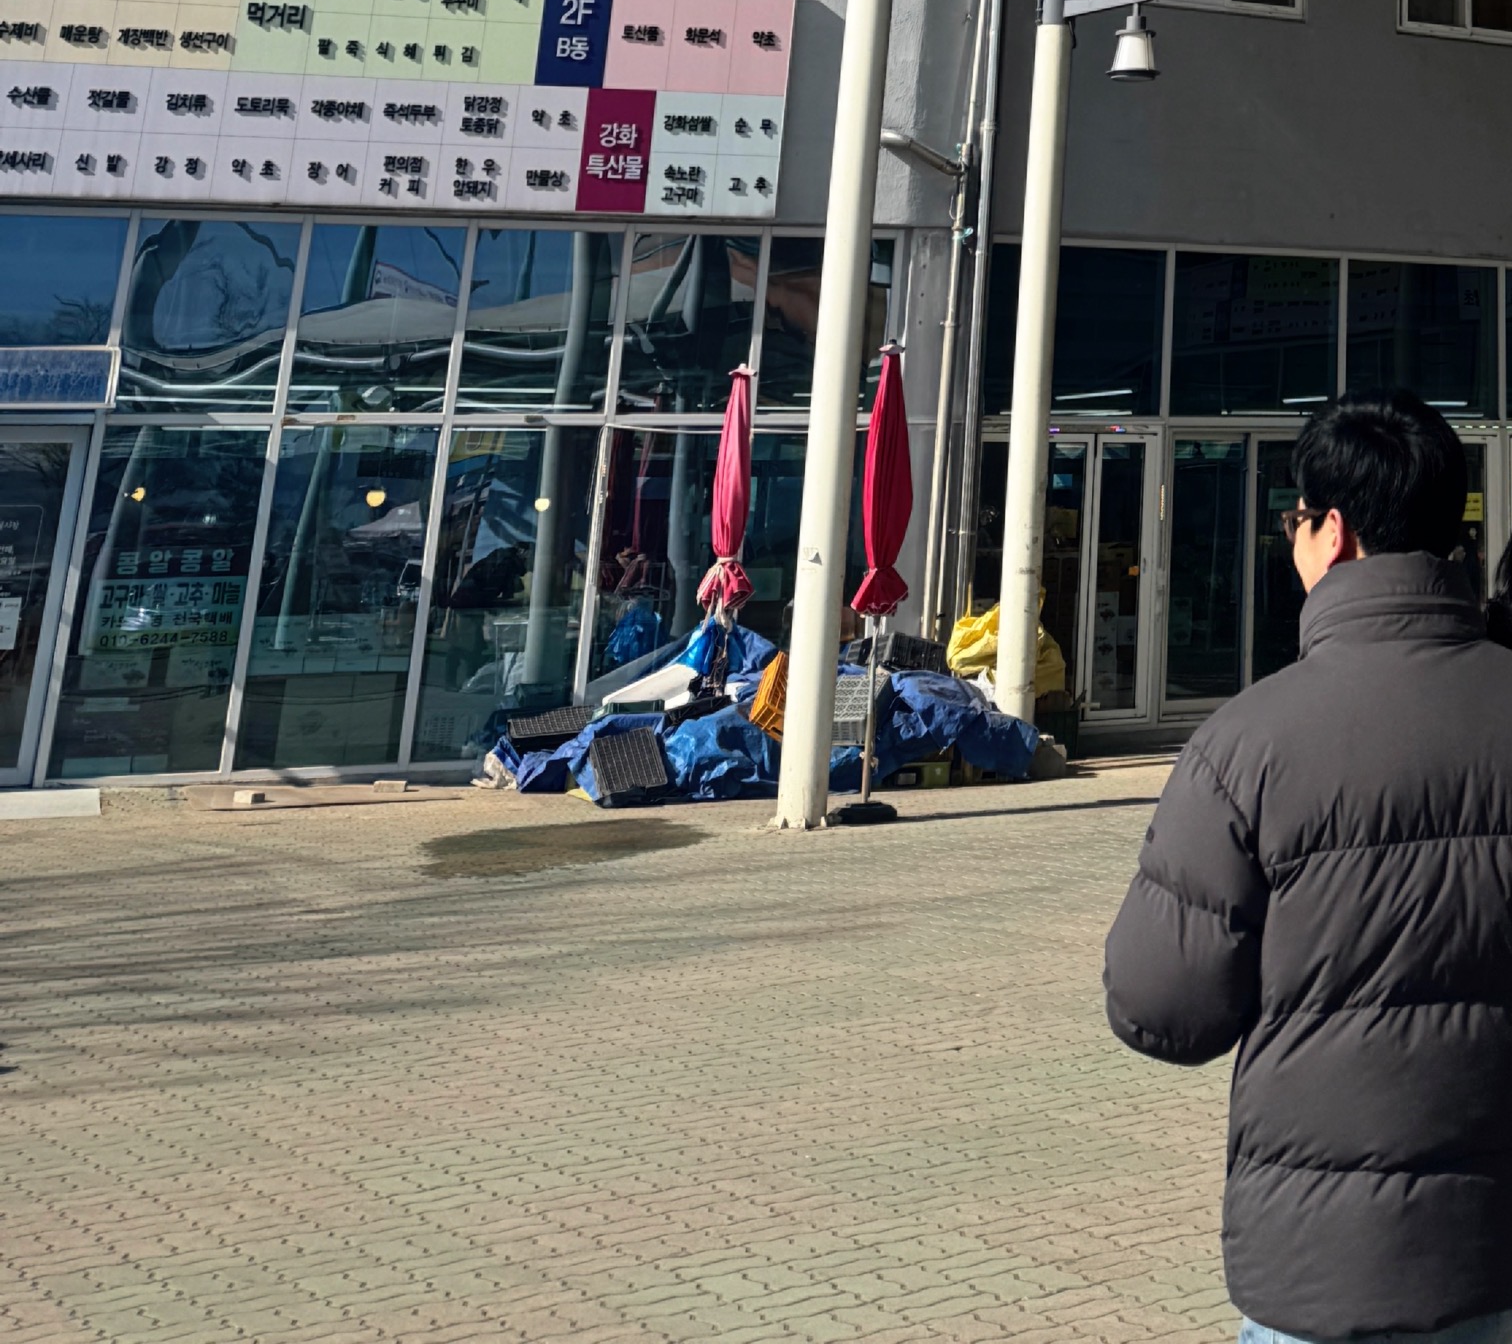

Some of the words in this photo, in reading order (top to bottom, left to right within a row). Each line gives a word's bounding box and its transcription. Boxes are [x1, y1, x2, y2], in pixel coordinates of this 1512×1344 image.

[248, 3, 306, 29] 먹거리
[60, 25, 103, 43] 매운탕
[118, 29, 168, 46] 게장백반
[180, 32, 229, 49] 생선구이
[623, 26, 659, 41] 토산품
[685, 28, 721, 44] 화문석
[753, 32, 775, 46] 약초
[556, 37, 590, 61] B동
[8, 87, 51, 105] 수산물
[167, 94, 206, 111] 김치류
[465, 96, 502, 113] 닭강정
[235, 98, 289, 115] 도토리묵
[312, 101, 364, 118] 각종야채
[384, 104, 436, 121] 즉석두부
[460, 118, 499, 134] 토종닭
[665, 116, 712, 132] 강화섬쌀
[599, 123, 638, 149] 강화
[384, 156, 422, 173] 편의점
[586, 155, 643, 181] 특산물
[527, 170, 564, 187] 만물상
[665, 165, 701, 182] 속노란
[454, 180, 491, 197] 암돼지
[662, 187, 698, 202] 고구마
[173, 612, 233, 626] 전국택배
